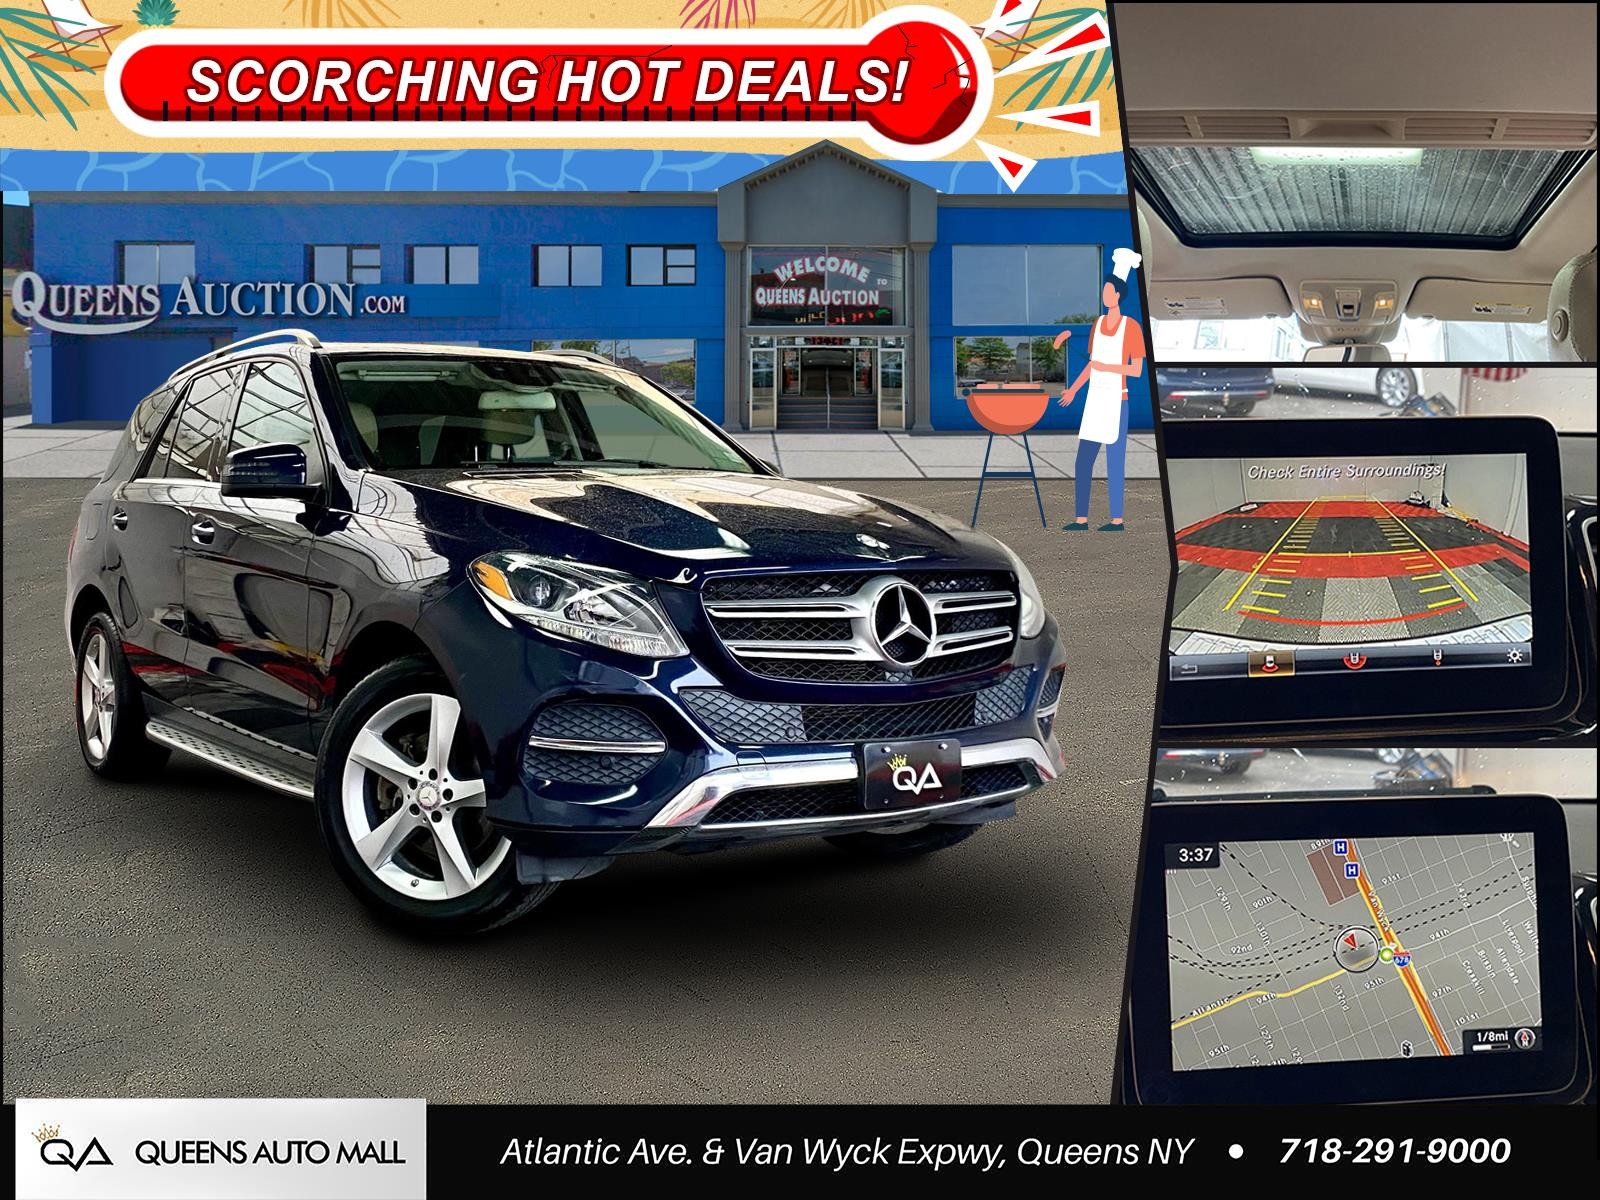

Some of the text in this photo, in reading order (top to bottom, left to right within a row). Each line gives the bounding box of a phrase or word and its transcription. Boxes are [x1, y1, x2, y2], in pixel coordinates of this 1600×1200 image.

[773, 256, 870, 284] WELCOME
[12, 271, 160, 335] QUEENS
[755, 287, 880, 306] QUEENS AUCTION
[1248, 463, 1448, 481] Check Entire Surroundings!
[1178, 847, 1214, 862] 3:37
[1381, 873, 1401, 886] 91st
[1252, 895, 1273, 909] 90th
[1255, 921, 1272, 946] 130th
[1429, 928, 1450, 942] 94th
[1502, 919, 1526, 956] Liverpool
[1230, 943, 1253, 954] 92nd
[1477, 949, 1497, 978] Brisbin
[1496, 947, 1520, 985] Allendale
[1364, 976, 1385, 990] 95th
[1256, 992, 1277, 1005] 94th
[1333, 985, 1350, 1011] 132nd
[1432, 985, 1453, 999] 97th
[1191, 997, 1229, 1017] Atlantic
[1455, 1012, 1480, 1026] 101st
[1259, 1024, 1275, 1050] 127th
[1477, 1030, 1509, 1043] 1/8mi
[1208, 1044, 1230, 1058] 95th
